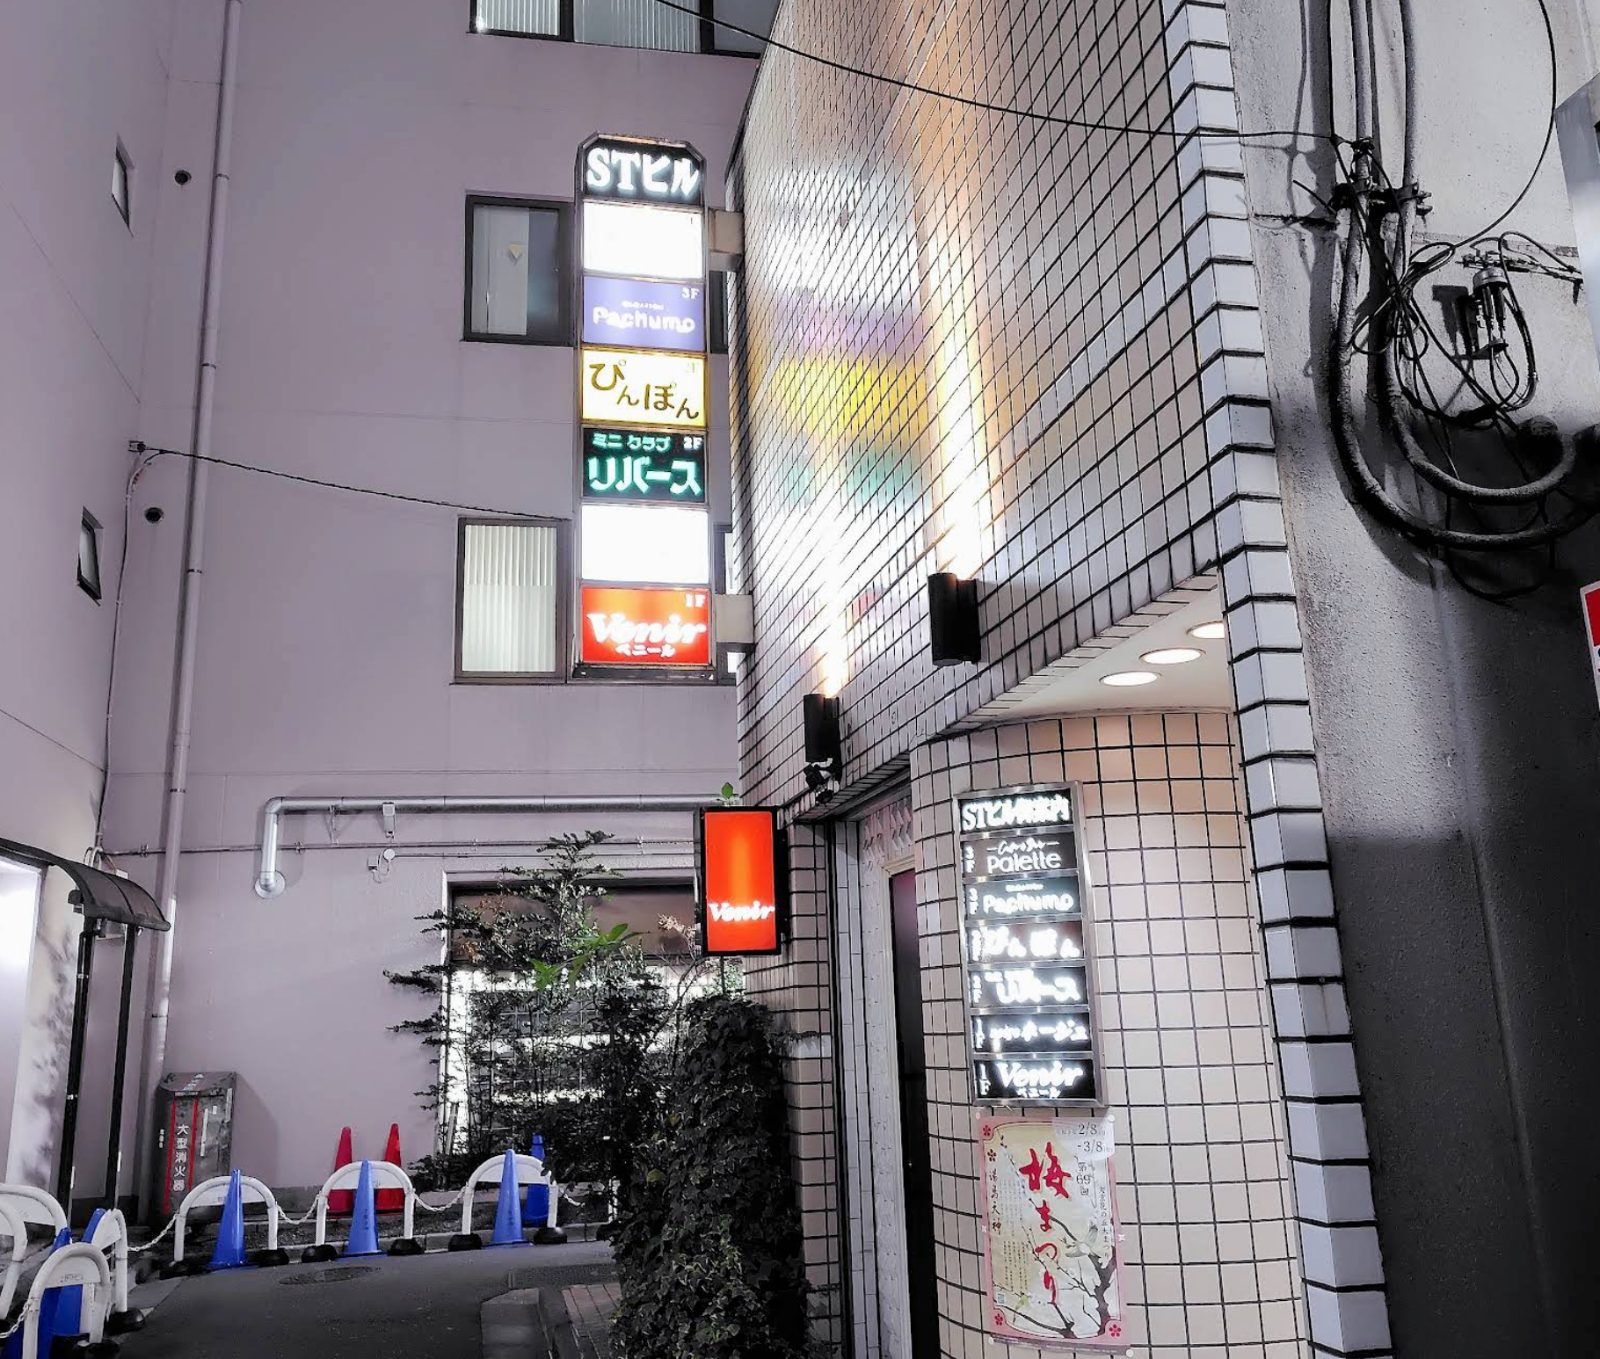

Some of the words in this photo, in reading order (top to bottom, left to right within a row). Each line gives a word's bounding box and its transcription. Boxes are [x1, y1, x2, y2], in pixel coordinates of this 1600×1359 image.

[681, 286, 700, 300] 3F
[592, 305, 697, 334] Pachumo
[588, 357, 700, 420] ぴんぽん
[683, 435, 704, 450] 2F
[587, 454, 703, 496] リバース
[685, 593, 706, 608] 1F
[586, 612, 707, 645] Venir
[986, 851, 1062, 875] Palette
[1077, 1121, 1098, 1137] 2/8
[173, 1124, 190, 1192] 大型消火器
[1019, 1141, 1072, 1304] 梅まつり
